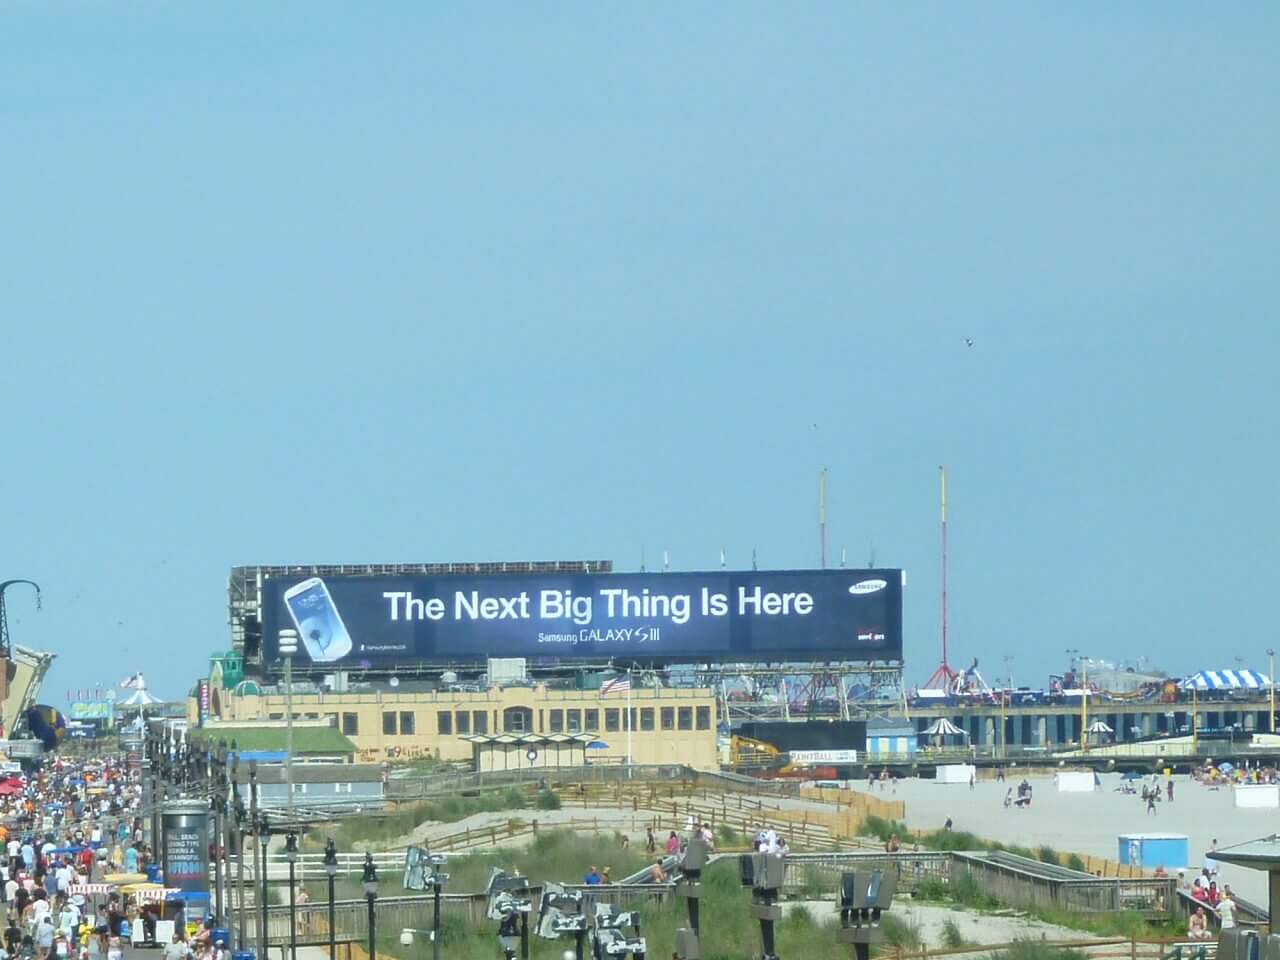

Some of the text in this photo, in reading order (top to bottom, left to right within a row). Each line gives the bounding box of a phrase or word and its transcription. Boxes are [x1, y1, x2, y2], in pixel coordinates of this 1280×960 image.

[382, 586, 814, 625] The Next Big Thing Is Here
[538, 632, 578, 645] Samsung
[579, 628, 633, 642] GALAXY
